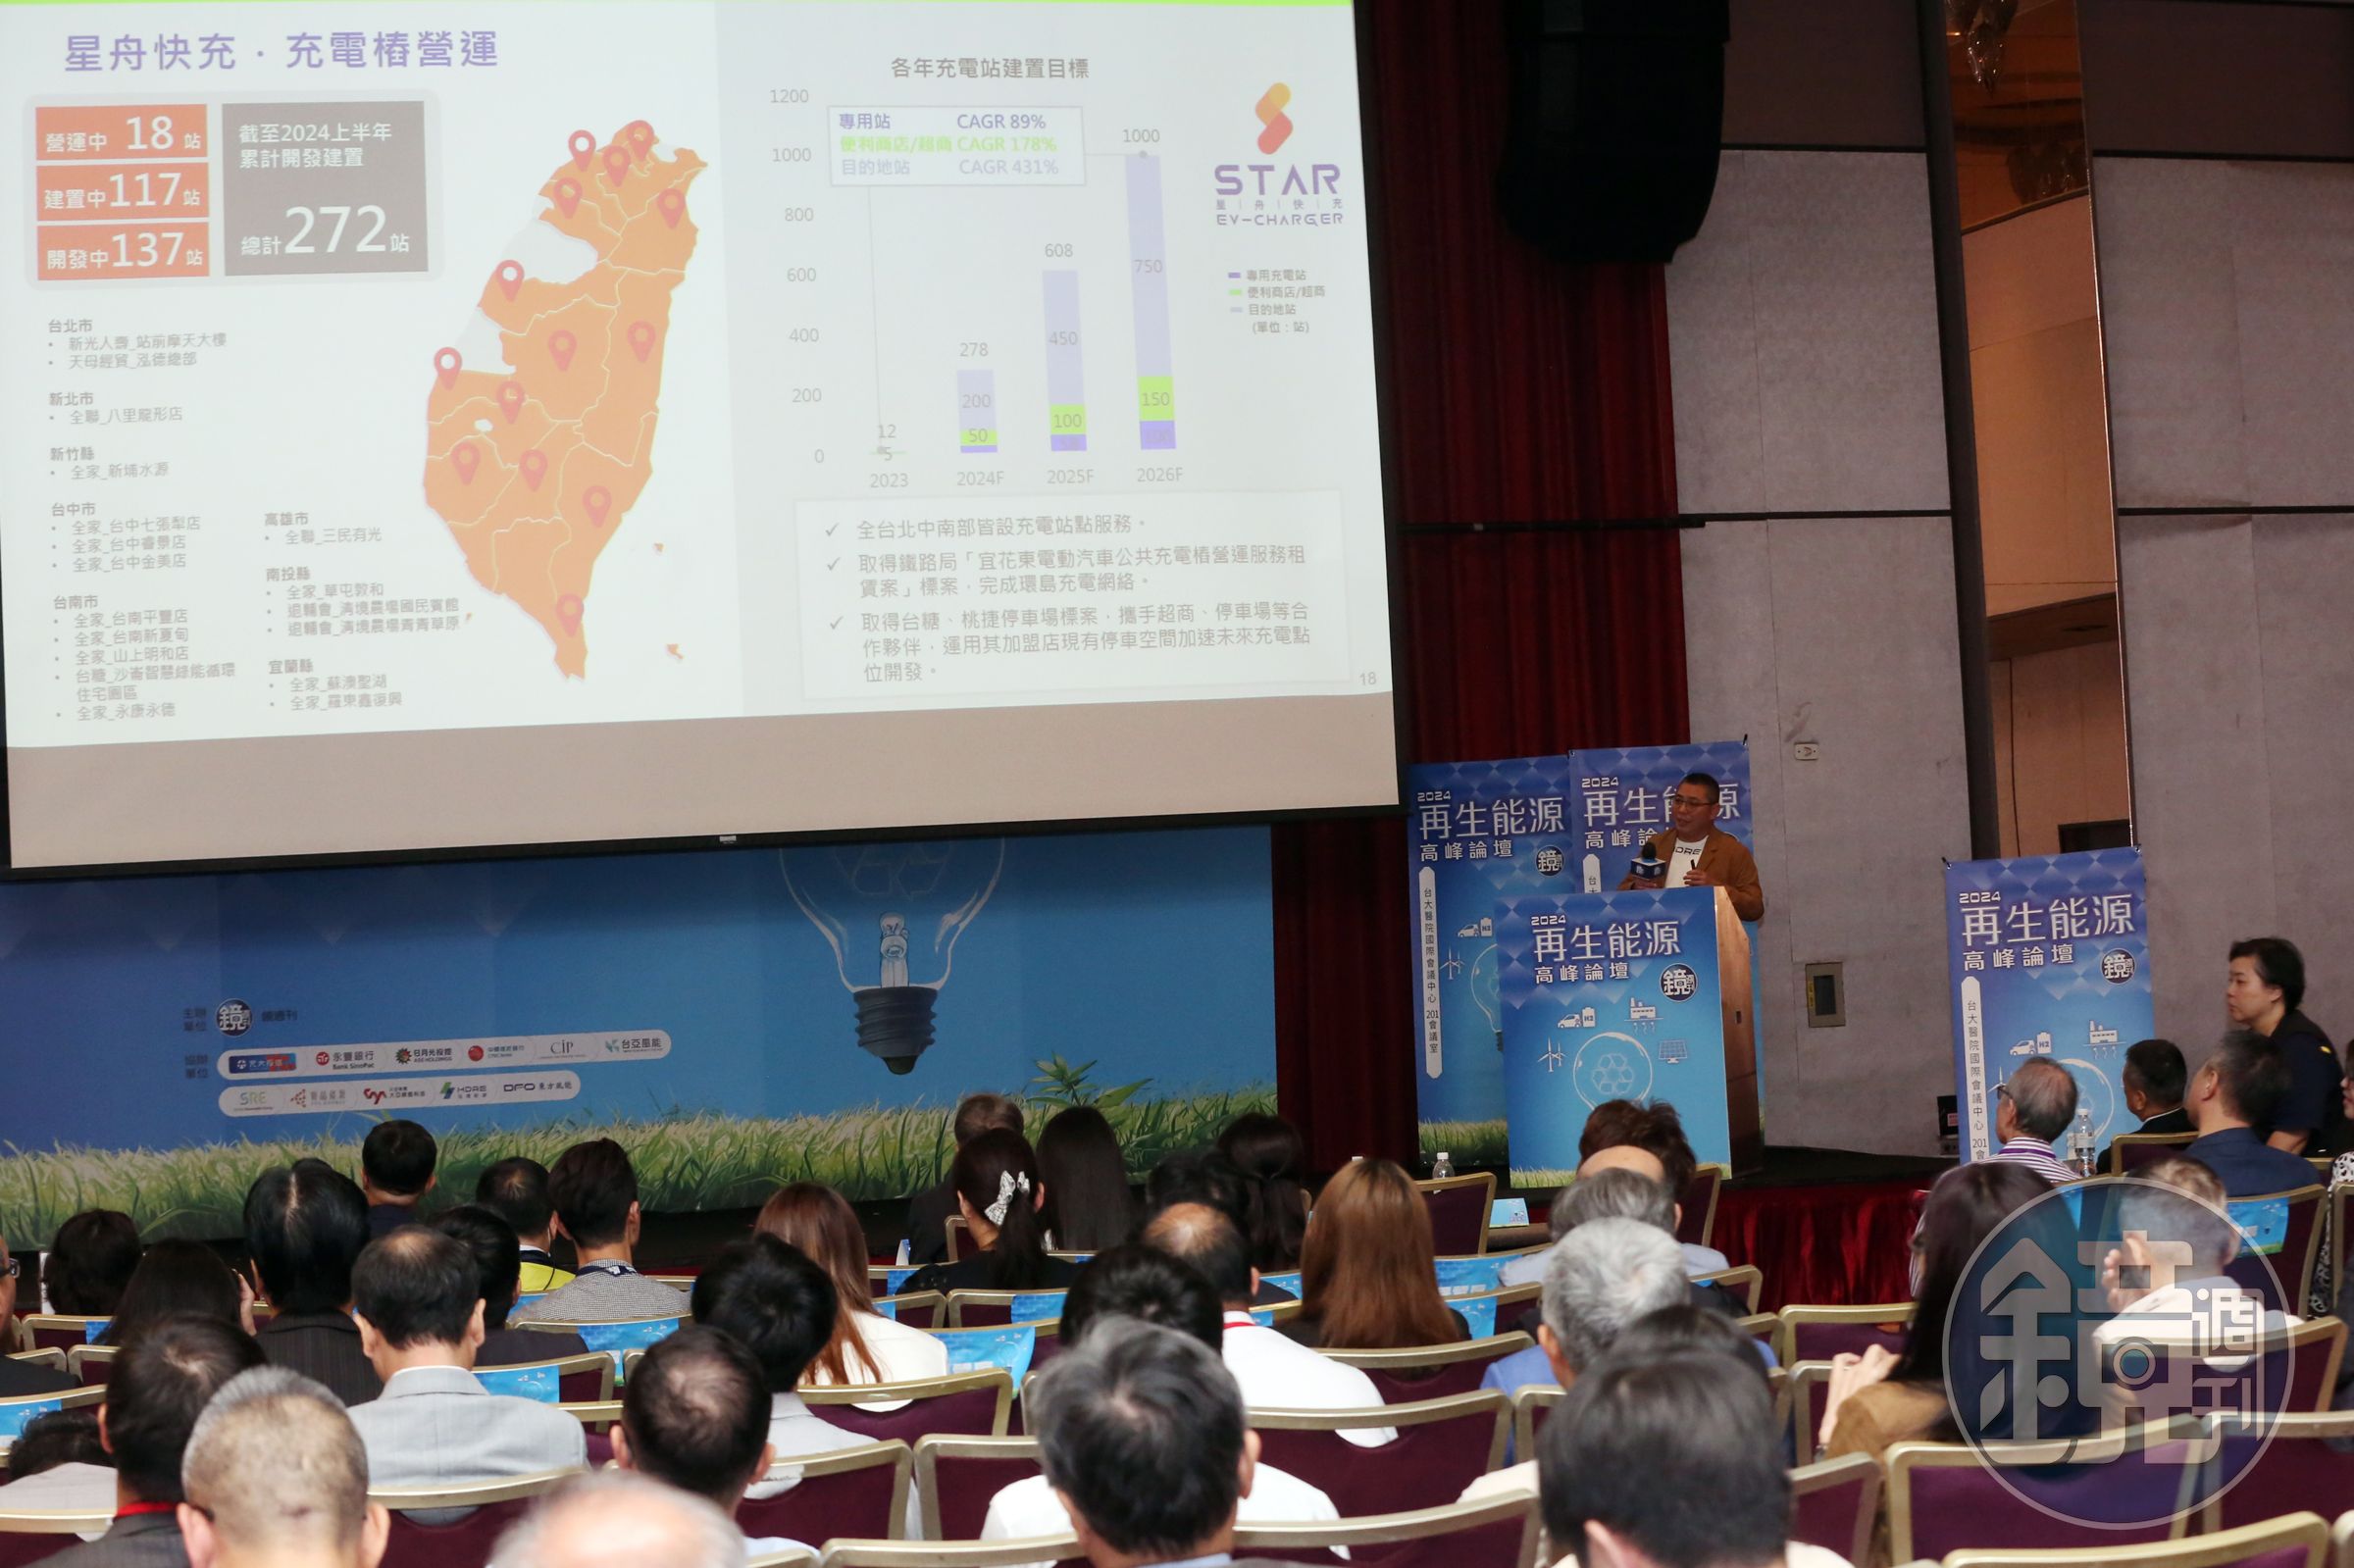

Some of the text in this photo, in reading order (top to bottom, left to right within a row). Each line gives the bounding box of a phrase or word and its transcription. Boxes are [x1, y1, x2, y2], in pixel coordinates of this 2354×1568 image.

[891, 57, 1091, 79] 各年充電站建置目標
[769, 88, 810, 105] 1200
[839, 112, 1048, 131] 專用站 CAGR 89%
[45, 116, 201, 153] 營運中 18 站
[238, 122, 392, 144] 截至2024上半年
[1122, 128, 1161, 144] 1000
[956, 136, 1006, 154] CAGR
[1010, 136, 1058, 153] 178%
[239, 147, 364, 170] 累計開發建置
[772, 148, 812, 163] 1000
[841, 158, 1060, 177] 目的地站 CAGR 431%
[1214, 163, 1341, 196] STAR
[44, 172, 201, 210] 建置中 117 站
[784, 208, 814, 223] 800
[1216, 212, 1344, 227] EV-CHARGER
[241, 205, 410, 257] 總計 272 站
[46, 231, 203, 271] 開發中 137 站
[1044, 243, 1074, 258] 608
[1134, 259, 1163, 274] 750
[786, 268, 817, 282] 600
[1247, 269, 1307, 282] 專用充電站
[1248, 284, 1326, 299] 便利商店/超商
[1248, 302, 1297, 317] 目的地站
[49, 319, 93, 333] 台北市
[789, 329, 820, 343] 400
[1049, 331, 1079, 346] 450
[959, 342, 990, 358] 278
[49, 392, 94, 406] 新北市
[792, 388, 823, 403] 200
[961, 394, 992, 409] 200
[1141, 392, 1170, 407] 150
[1052, 414, 1083, 429] 100
[878, 424, 897, 439] 12
[968, 429, 989, 443] 50
[50, 446, 95, 462] 新竹縣
[814, 449, 825, 465] 0
[869, 474, 909, 489] 2023
[956, 472, 1004, 487] 2024F
[1047, 469, 1096, 484] 2025F
[1137, 468, 1184, 482] 2026F
[51, 502, 96, 517] 台中市
[264, 512, 309, 527] 高雄市
[266, 566, 311, 582] 南投縣
[53, 594, 98, 610] 台南市
[269, 659, 314, 675] 宜蘭縣
[1359, 672, 1377, 685] 18
[1581, 776, 1619, 788] 2024
[1417, 790, 1452, 802] 2024
[1418, 795, 1565, 840] 再生能源
[1420, 838, 1513, 862] 高峰論壇
[1959, 890, 2001, 903] 2024
[1531, 914, 1566, 927] 2024
[1961, 893, 2135, 946] 再生能源
[1533, 920, 1682, 963] 再生能源
[1963, 944, 2074, 972] 高峰論壇
[1534, 962, 1629, 985] 高峰論壇
[503, 1083, 536, 1092] DFO
[239, 1090, 267, 1106] SRE
